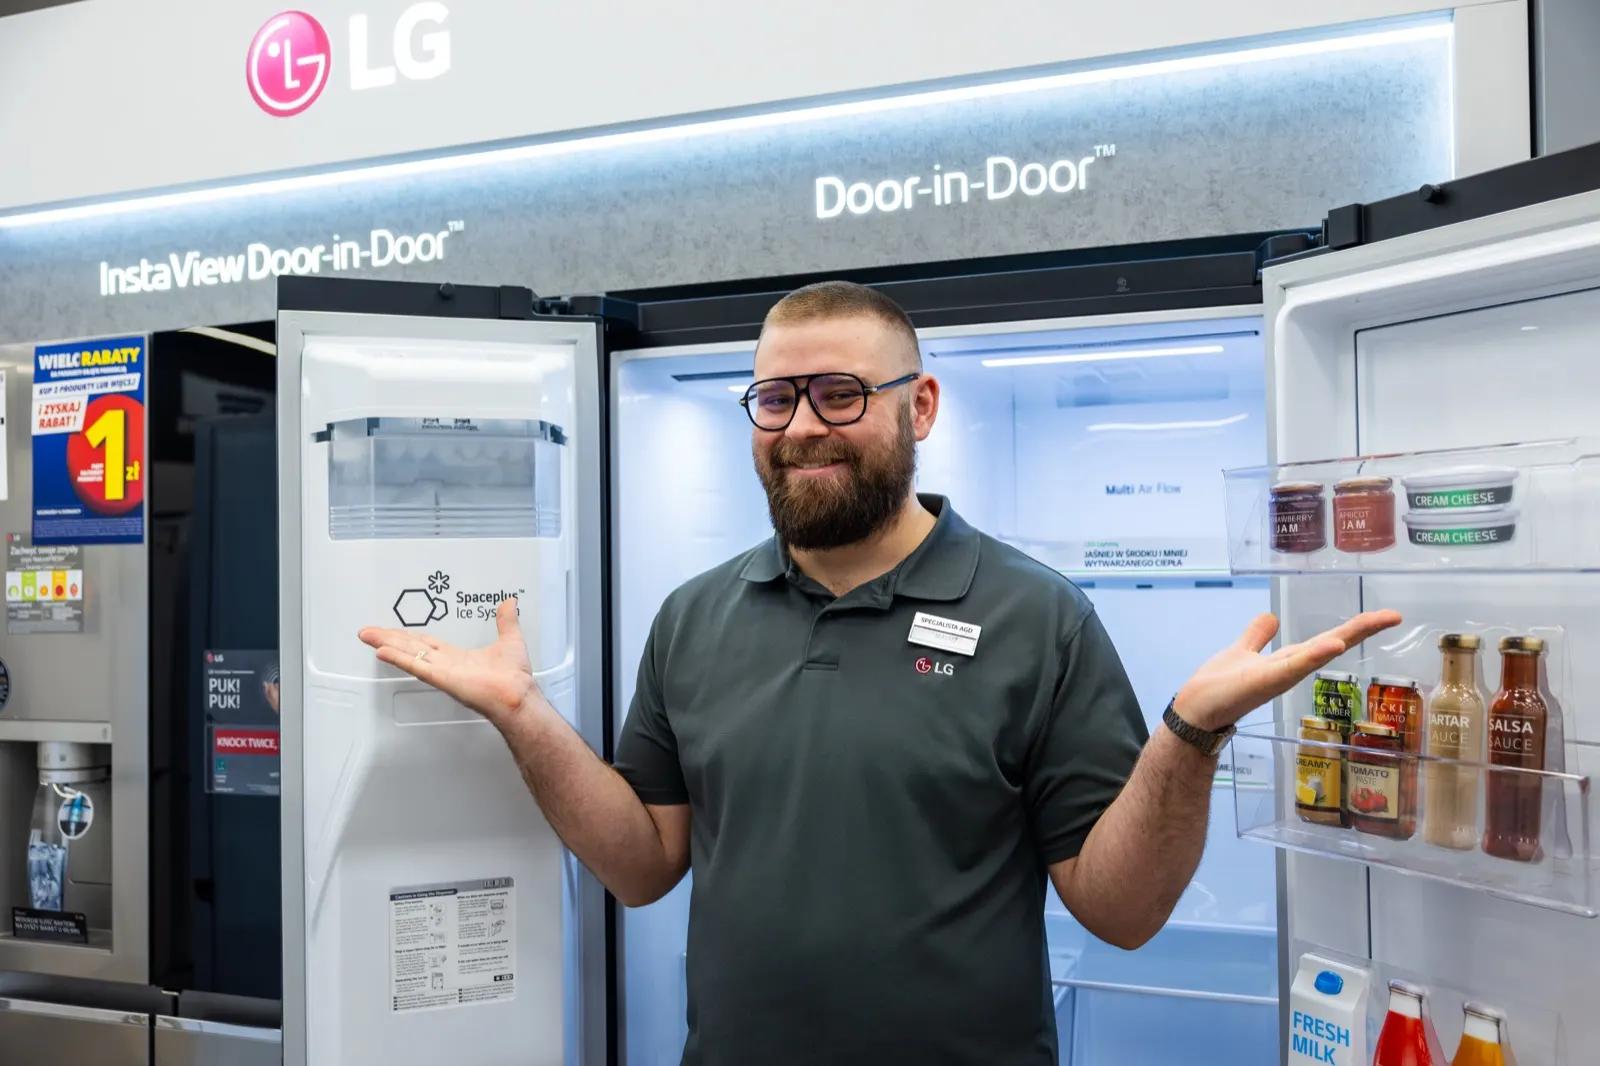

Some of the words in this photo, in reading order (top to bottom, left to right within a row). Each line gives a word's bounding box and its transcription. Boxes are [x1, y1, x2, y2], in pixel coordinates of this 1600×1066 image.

[349, 1, 451, 90] LG
[100, 251, 246, 296] InstaView
[39, 387, 52, 395] KUP
[60, 383, 94, 393] PRODUKTY
[96, 381, 109, 389] LUB
[44, 401, 81, 415] ZYSKAJ
[85, 409, 125, 500] 1
[126, 460, 140, 481] zł
[1105, 484, 1135, 495] Multi
[1138, 484, 1152, 494] Air
[1155, 482, 1181, 494] Flow
[1415, 495, 1449, 506] CREAM
[1451, 491, 1496, 505] CHEESE
[1339, 510, 1369, 520] APRICOT
[1276, 523, 1298, 534] JAM
[1341, 519, 1366, 530] JAM
[1415, 532, 1450, 543] CREAM
[1452, 529, 1499, 543] CHEESE
[1084, 549, 1114, 559] JAŚNIEJ
[1115, 550, 1124, 558] W
[1125, 547, 1158, 558] ŚRODKU
[1163, 549, 1188, 557] MNIEJ
[1084, 559, 1154, 568] WYTWARZANEGO
[1155, 558, 1183, 568] CIEPŁA
[456, 607, 473, 619] Ice
[921, 617, 958, 630] SPECJALISTA
[934, 662, 954, 676] LG
[208, 678, 240, 693] PUK!
[208, 694, 240, 709] PUK!
[1369, 701, 1417, 715] PICKLE
[1488, 718, 1534, 734] SALSA
[216, 737, 249, 748] KNOCK
[1431, 730, 1469, 745] AUCE
[1488, 734, 1534, 751] SAUCE
[1350, 765, 1390, 779] TOMATO
[1293, 1011, 1350, 1047] FRESH
[1293, 1032, 1336, 1066] MILK
